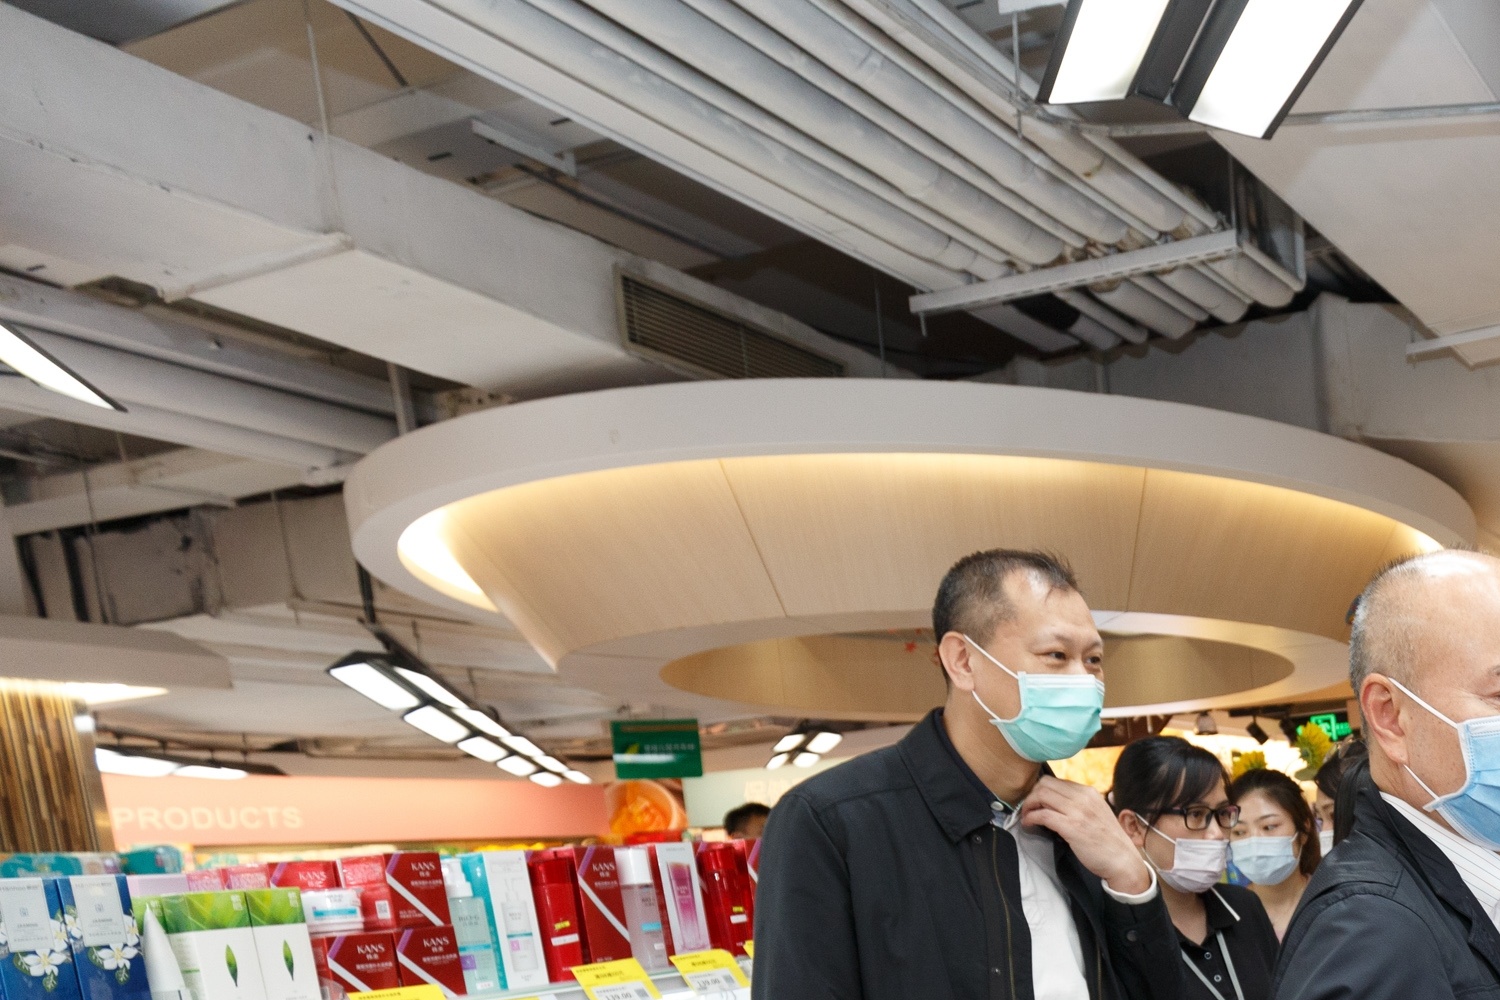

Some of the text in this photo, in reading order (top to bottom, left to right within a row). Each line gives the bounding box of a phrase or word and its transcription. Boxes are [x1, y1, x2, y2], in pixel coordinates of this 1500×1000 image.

[113, 806, 304, 831] PRODUCTS
[411, 862, 436, 871] KANS
[592, 862, 615, 872] KANS
[423, 936, 449, 948] KANS
[357, 944, 385, 955] KANS
